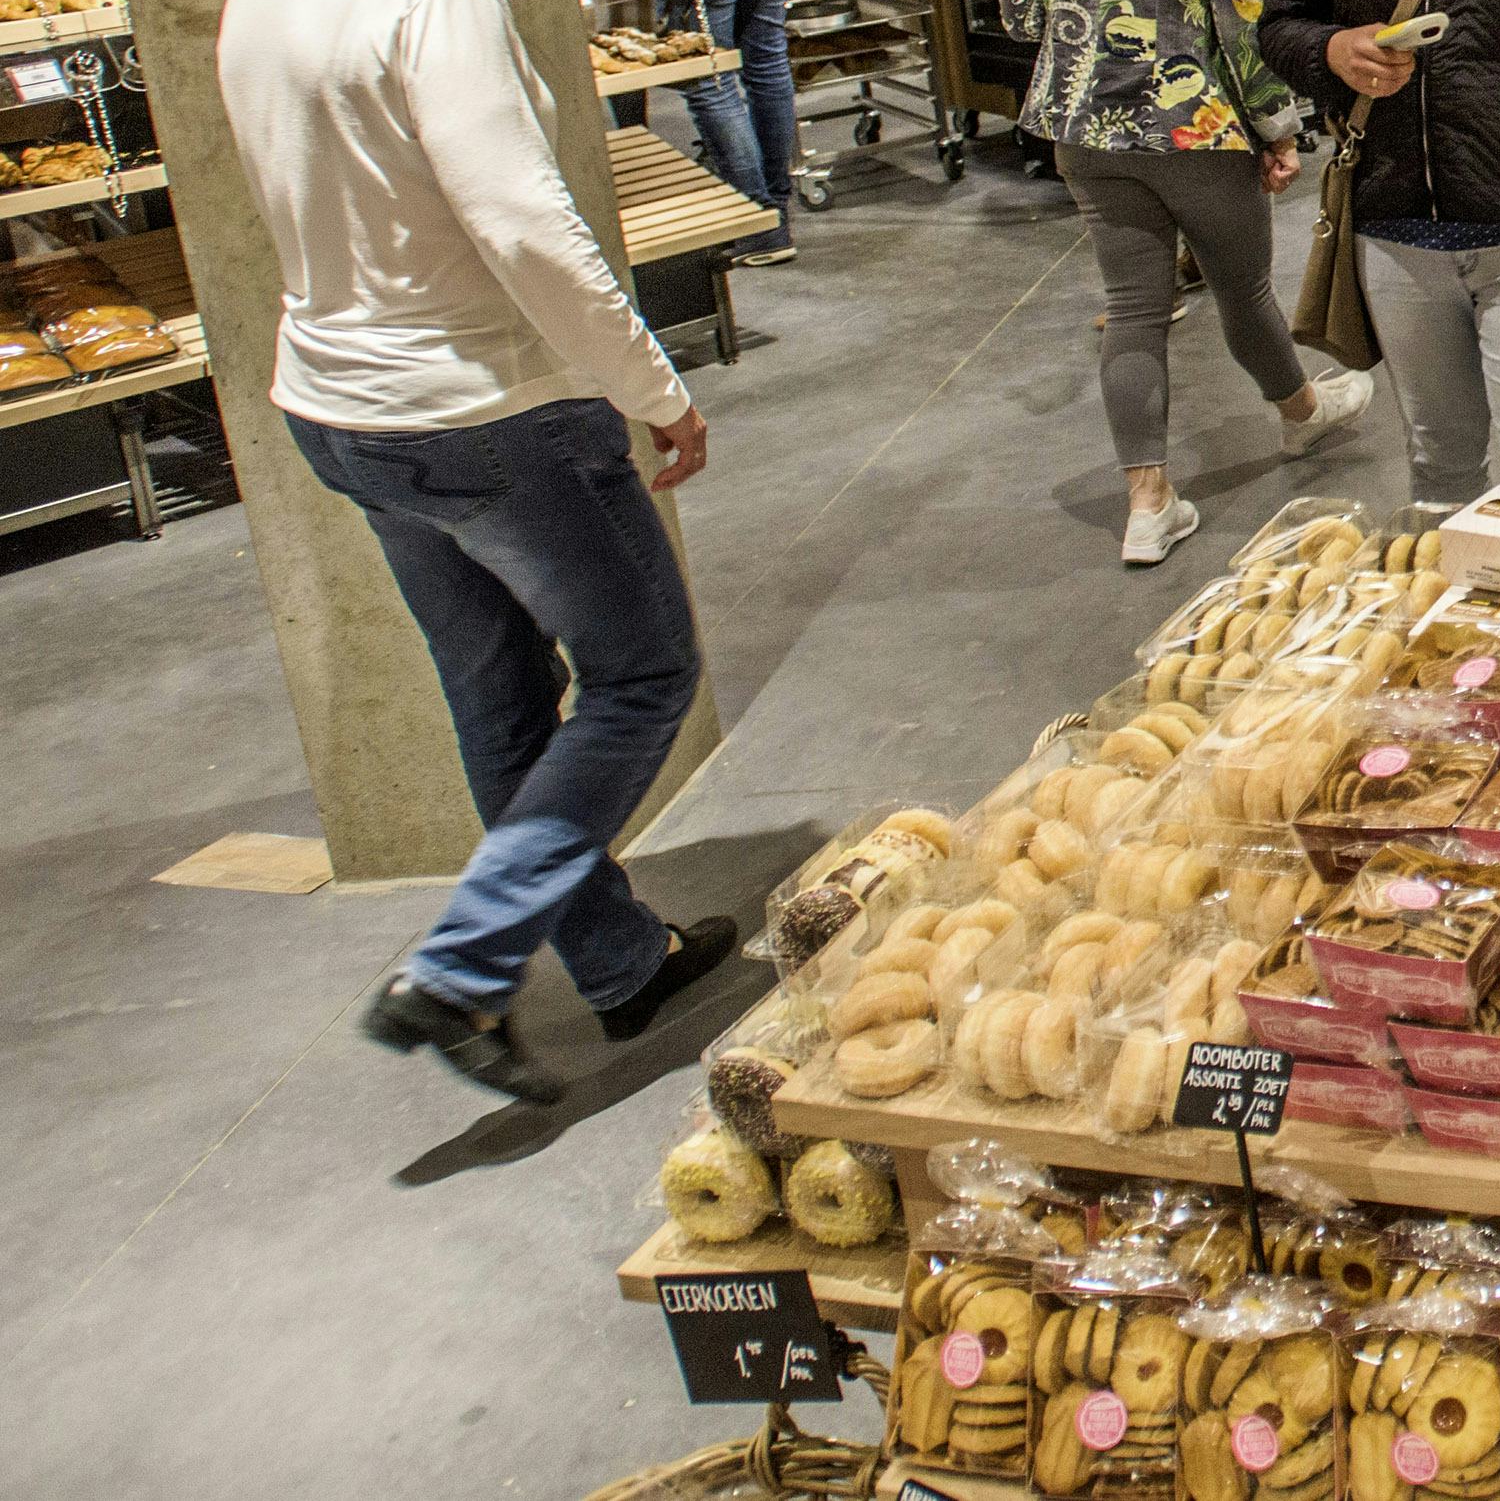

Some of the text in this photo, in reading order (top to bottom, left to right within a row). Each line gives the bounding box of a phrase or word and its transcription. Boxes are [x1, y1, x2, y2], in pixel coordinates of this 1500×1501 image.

[1191, 1046, 1283, 1073] ROOMBOTER
[1183, 1067, 1290, 1097] ASSORTI ZOET
[1255, 1098, 1275, 1114] PER
[1249, 1112, 1271, 1129] PAK
[660, 1281, 778, 1315] EIERKOEKEN
